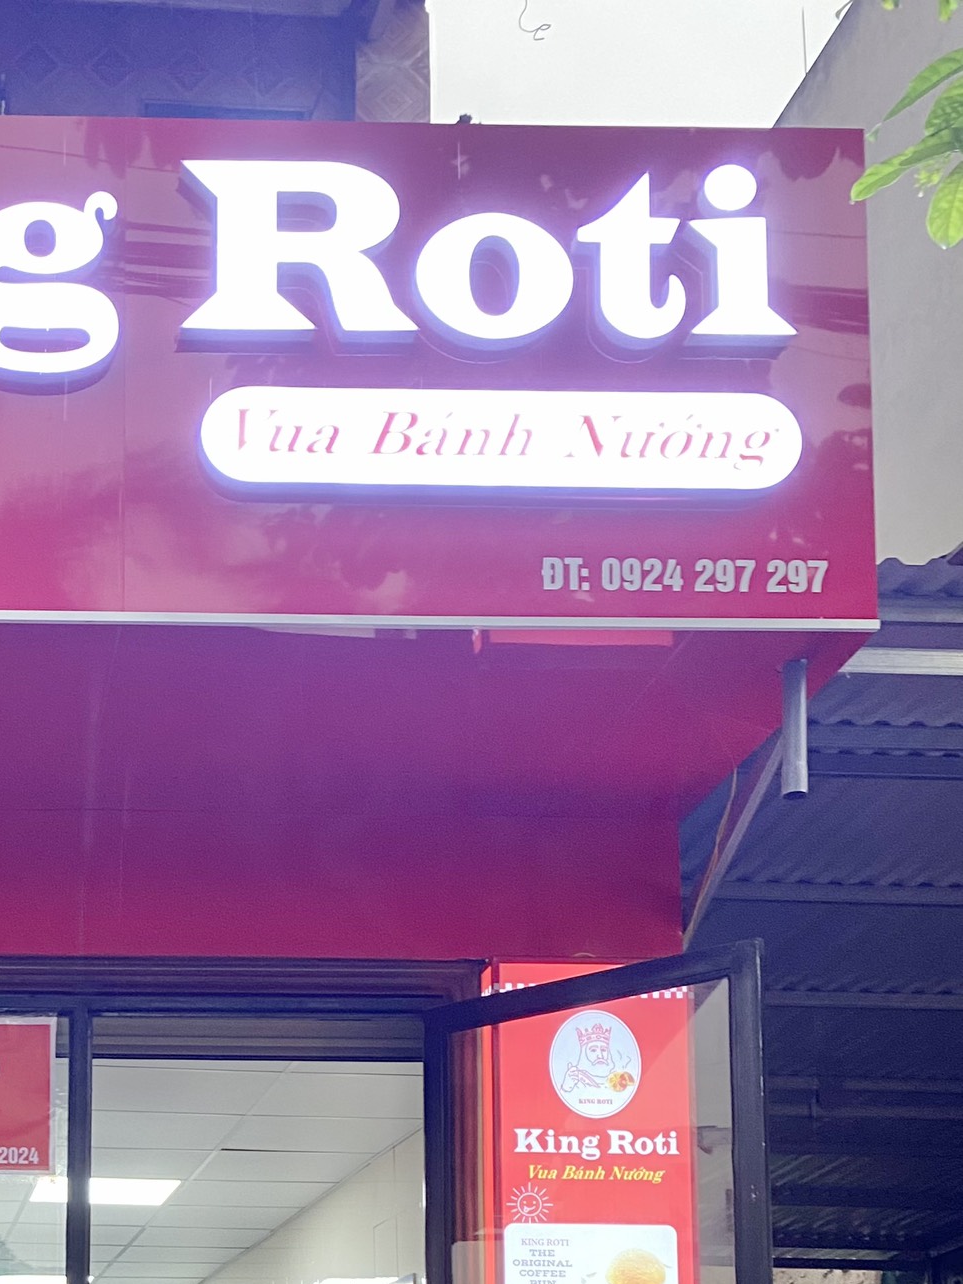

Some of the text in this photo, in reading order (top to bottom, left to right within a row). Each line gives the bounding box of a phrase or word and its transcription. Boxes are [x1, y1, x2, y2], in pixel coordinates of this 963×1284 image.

[179, 158, 798, 341] Roti
[235, 408, 780, 470] Vua Bánh Nướng
[541, 557, 829, 594] ĐT: 0924 297 297
[513, 1128, 680, 1161] King Roti
[528, 1164, 666, 1184] Vua Bánh Nướng
[521, 1238, 570, 1247] KING ROTI
[512, 1258, 573, 1268] ORIGINAL
[529, 1249, 556, 1257] THE
[519, 1269, 567, 1278] COFFEE
